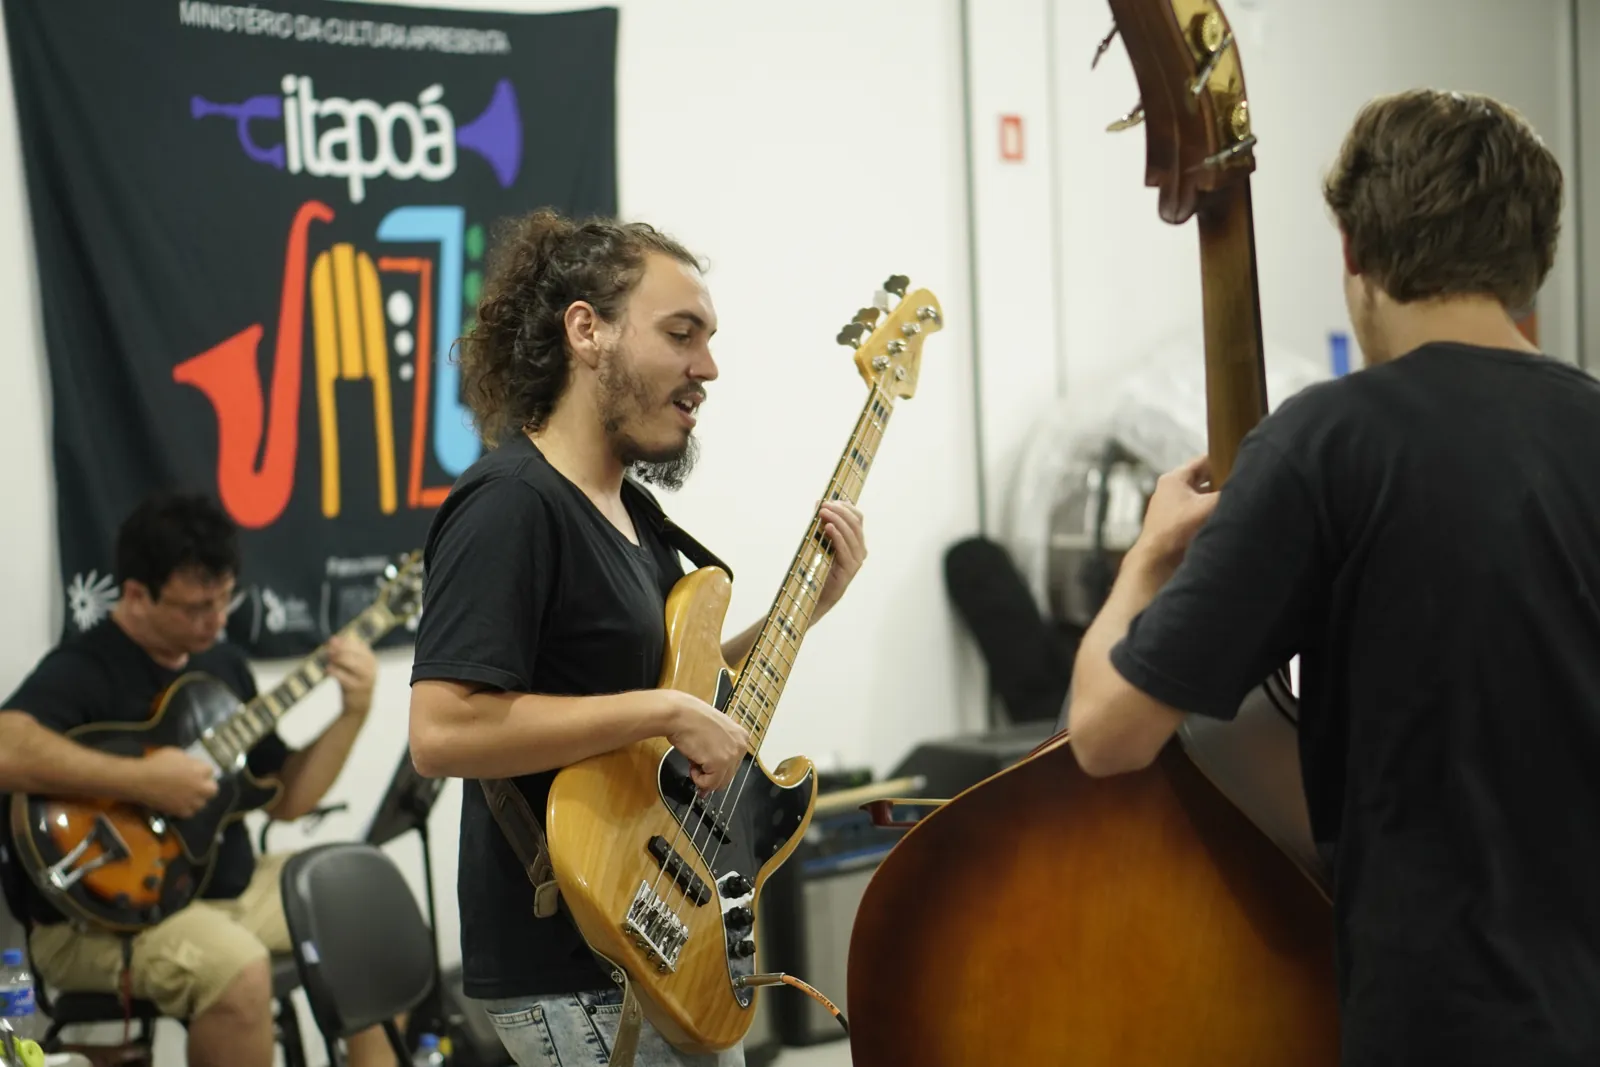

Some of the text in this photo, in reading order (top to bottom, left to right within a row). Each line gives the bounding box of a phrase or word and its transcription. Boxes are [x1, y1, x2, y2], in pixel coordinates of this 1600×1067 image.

[179, 0, 512, 54] MINISTÉRIO DA CULTURA APRESENTA
[281, 74, 457, 204] itapoá
